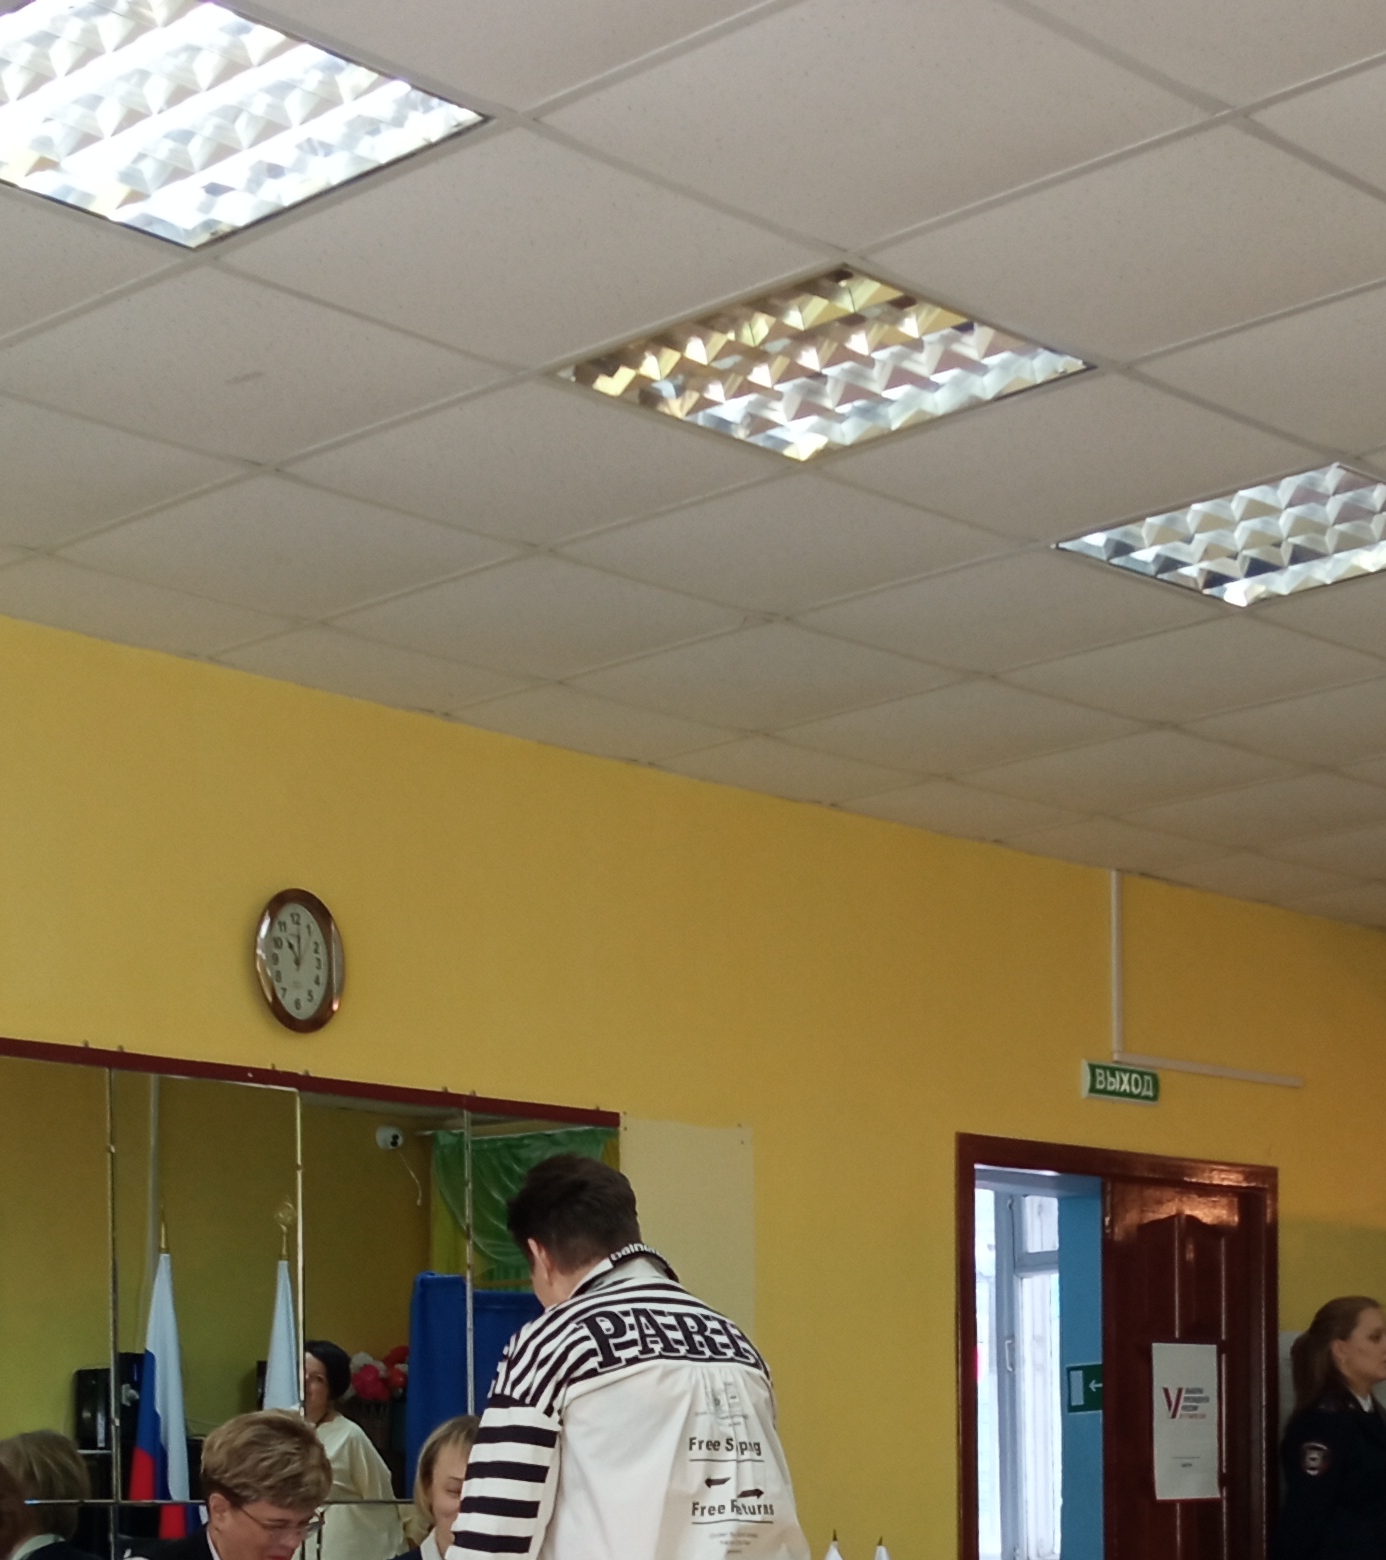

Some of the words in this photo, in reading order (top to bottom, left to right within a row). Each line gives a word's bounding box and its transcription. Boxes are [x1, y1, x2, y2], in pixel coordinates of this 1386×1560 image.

[1095, 1068, 1154, 1098] ВЫХОД
[688, 1436, 721, 1451] Free
[691, 1502, 726, 1517] Free
